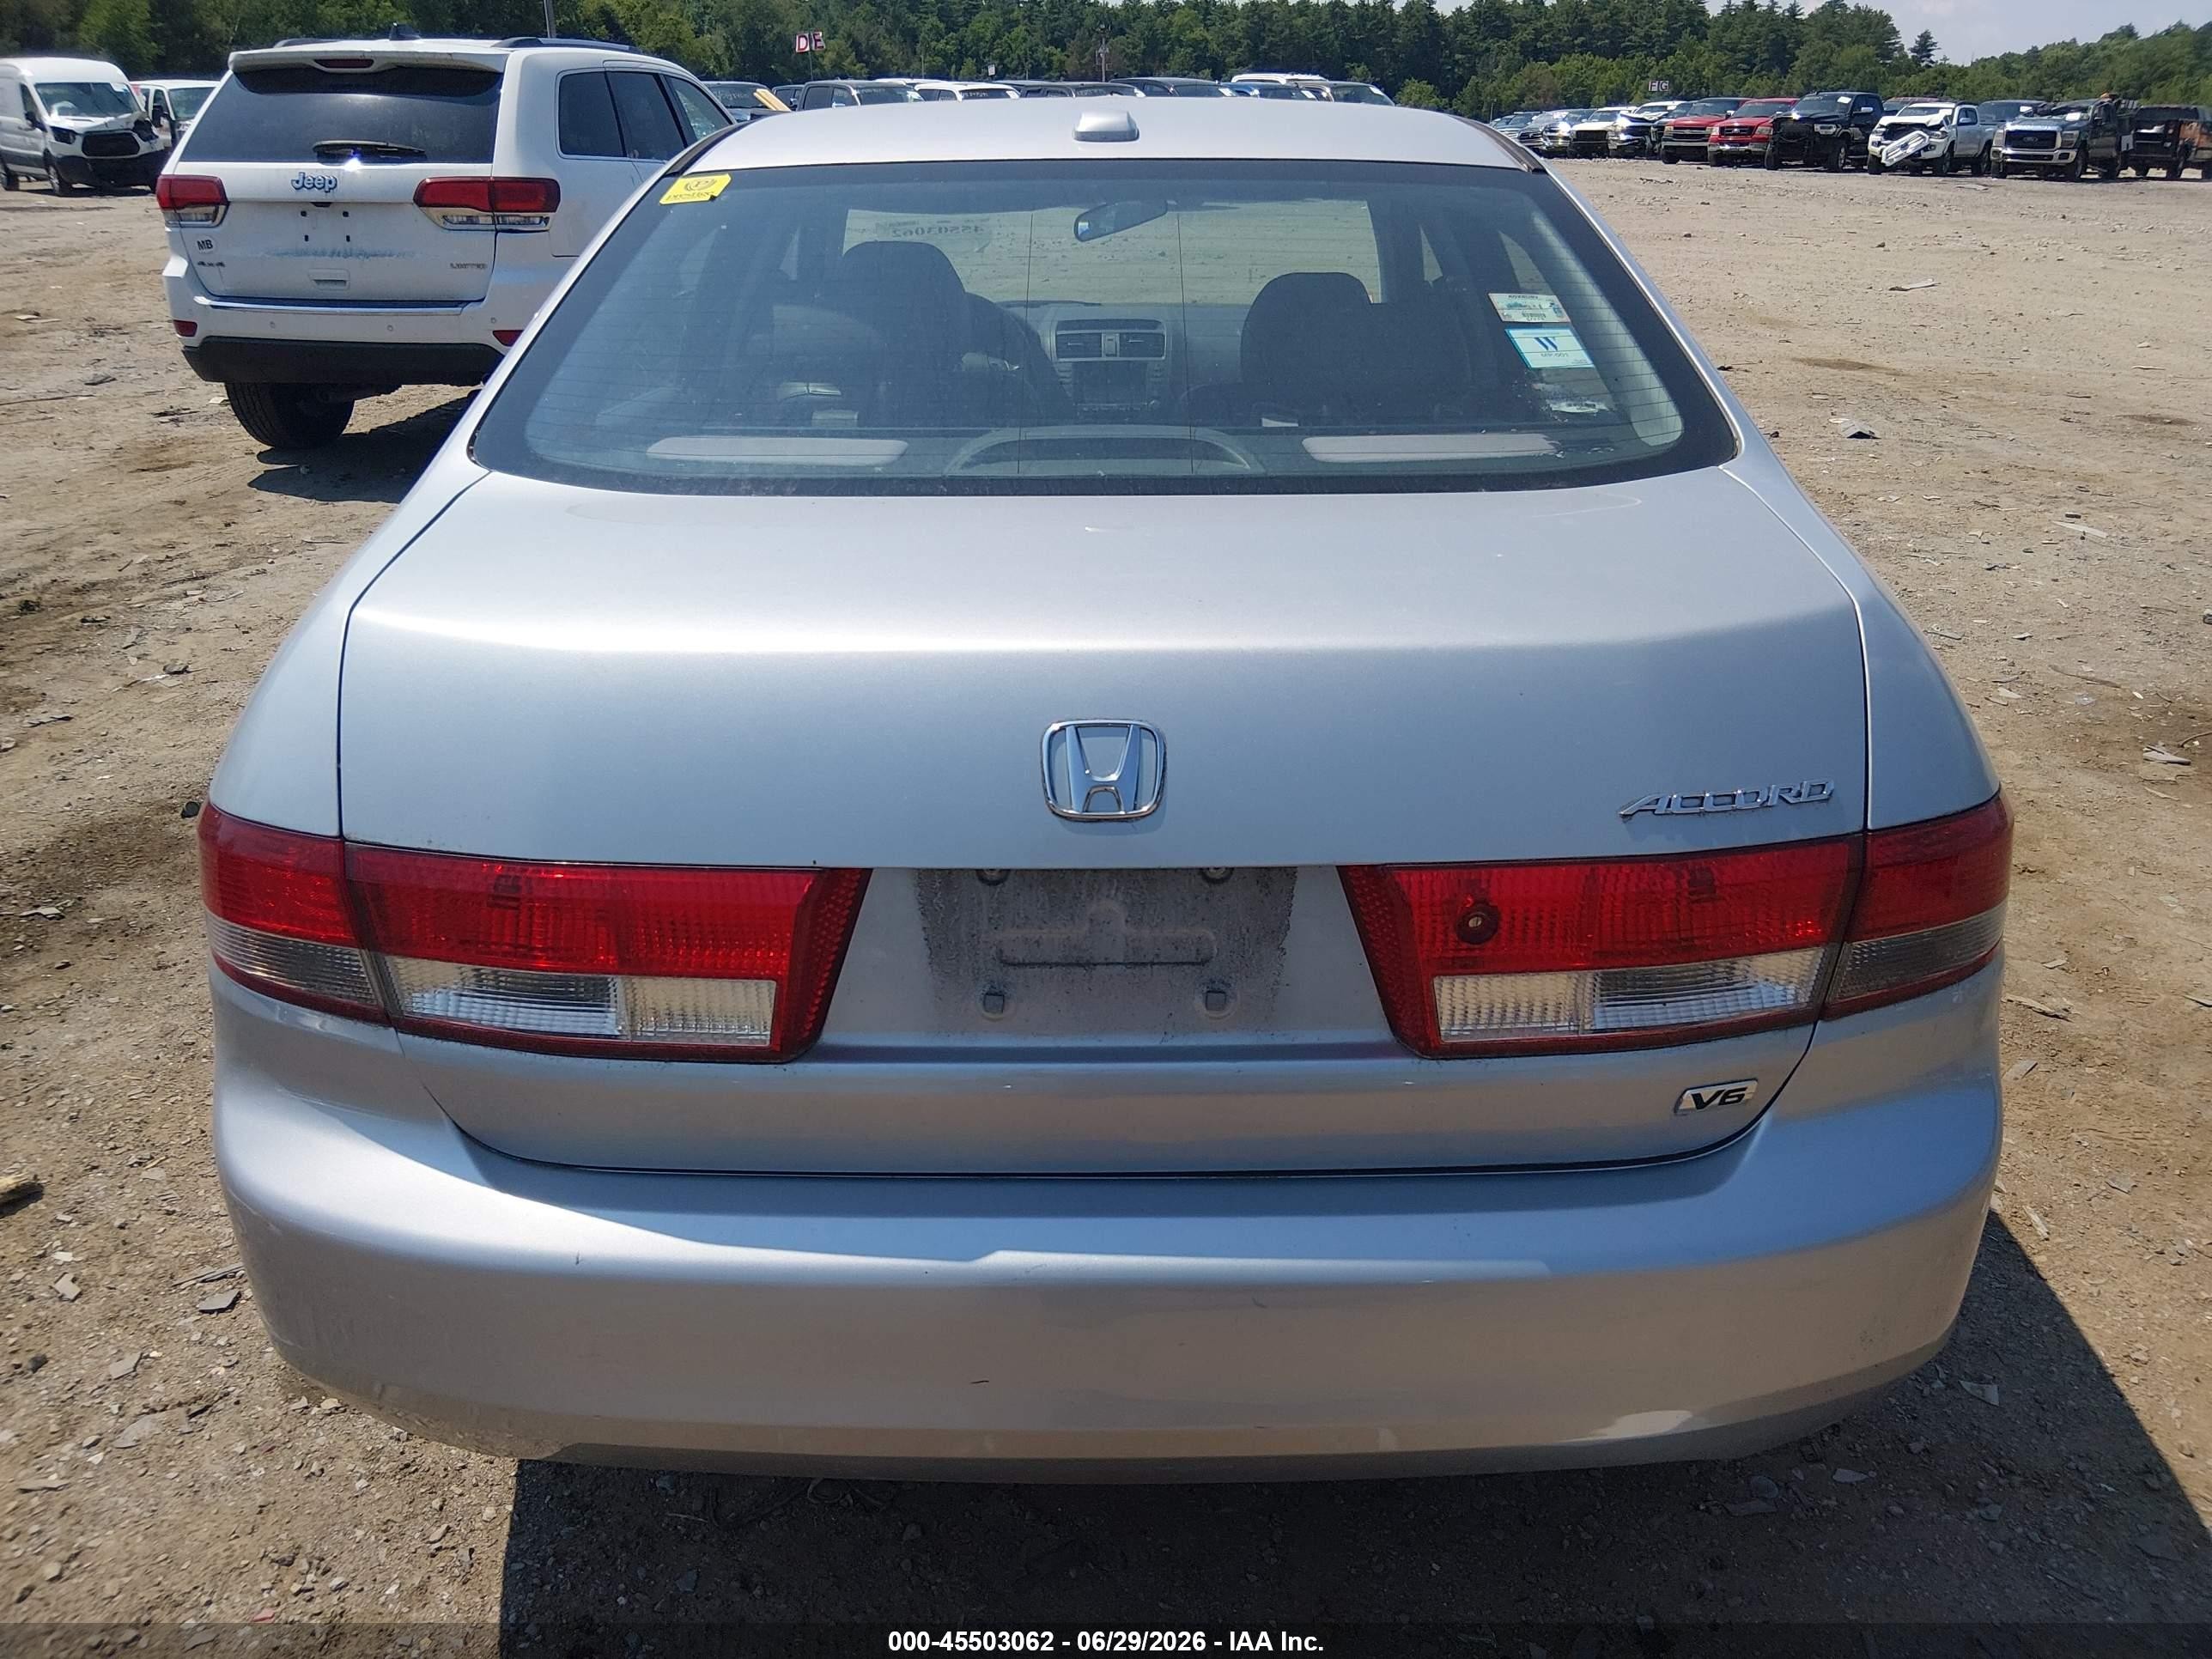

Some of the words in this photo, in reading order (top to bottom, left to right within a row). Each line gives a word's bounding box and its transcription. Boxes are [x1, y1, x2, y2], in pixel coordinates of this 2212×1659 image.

[797, 35, 809, 51] D
[812, 33, 824, 50] E
[290, 172, 338, 193] Jeep
[197, 239, 214, 251] MB
[1619, 779, 1835, 817] ACCORD
[1691, 1086, 1748, 1110] V6
